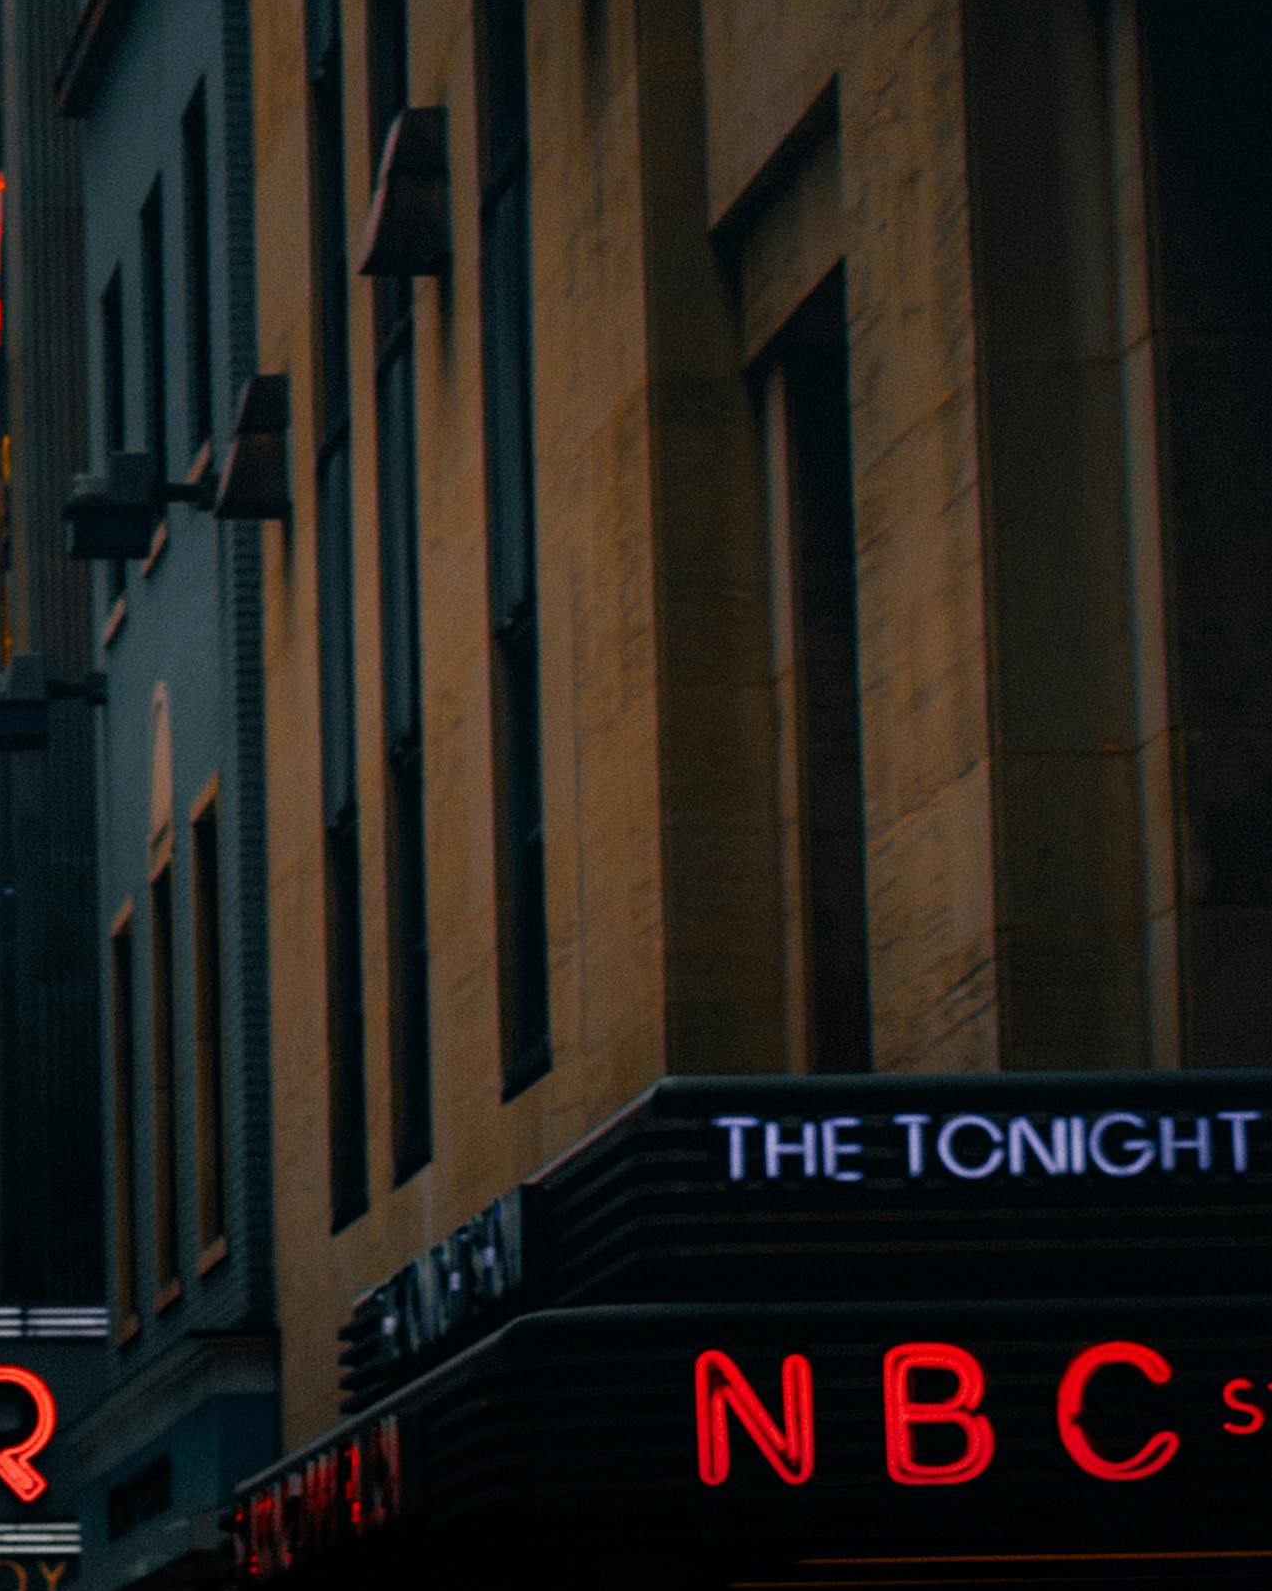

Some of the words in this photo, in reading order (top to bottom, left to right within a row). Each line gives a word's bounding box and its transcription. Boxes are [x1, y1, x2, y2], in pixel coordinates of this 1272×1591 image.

[712, 1112, 866, 1184] THE
[893, 1108, 1264, 1181] TONIGHT
[693, 1338, 1182, 1487] NBC
[1221, 1376, 1272, 1436] S
